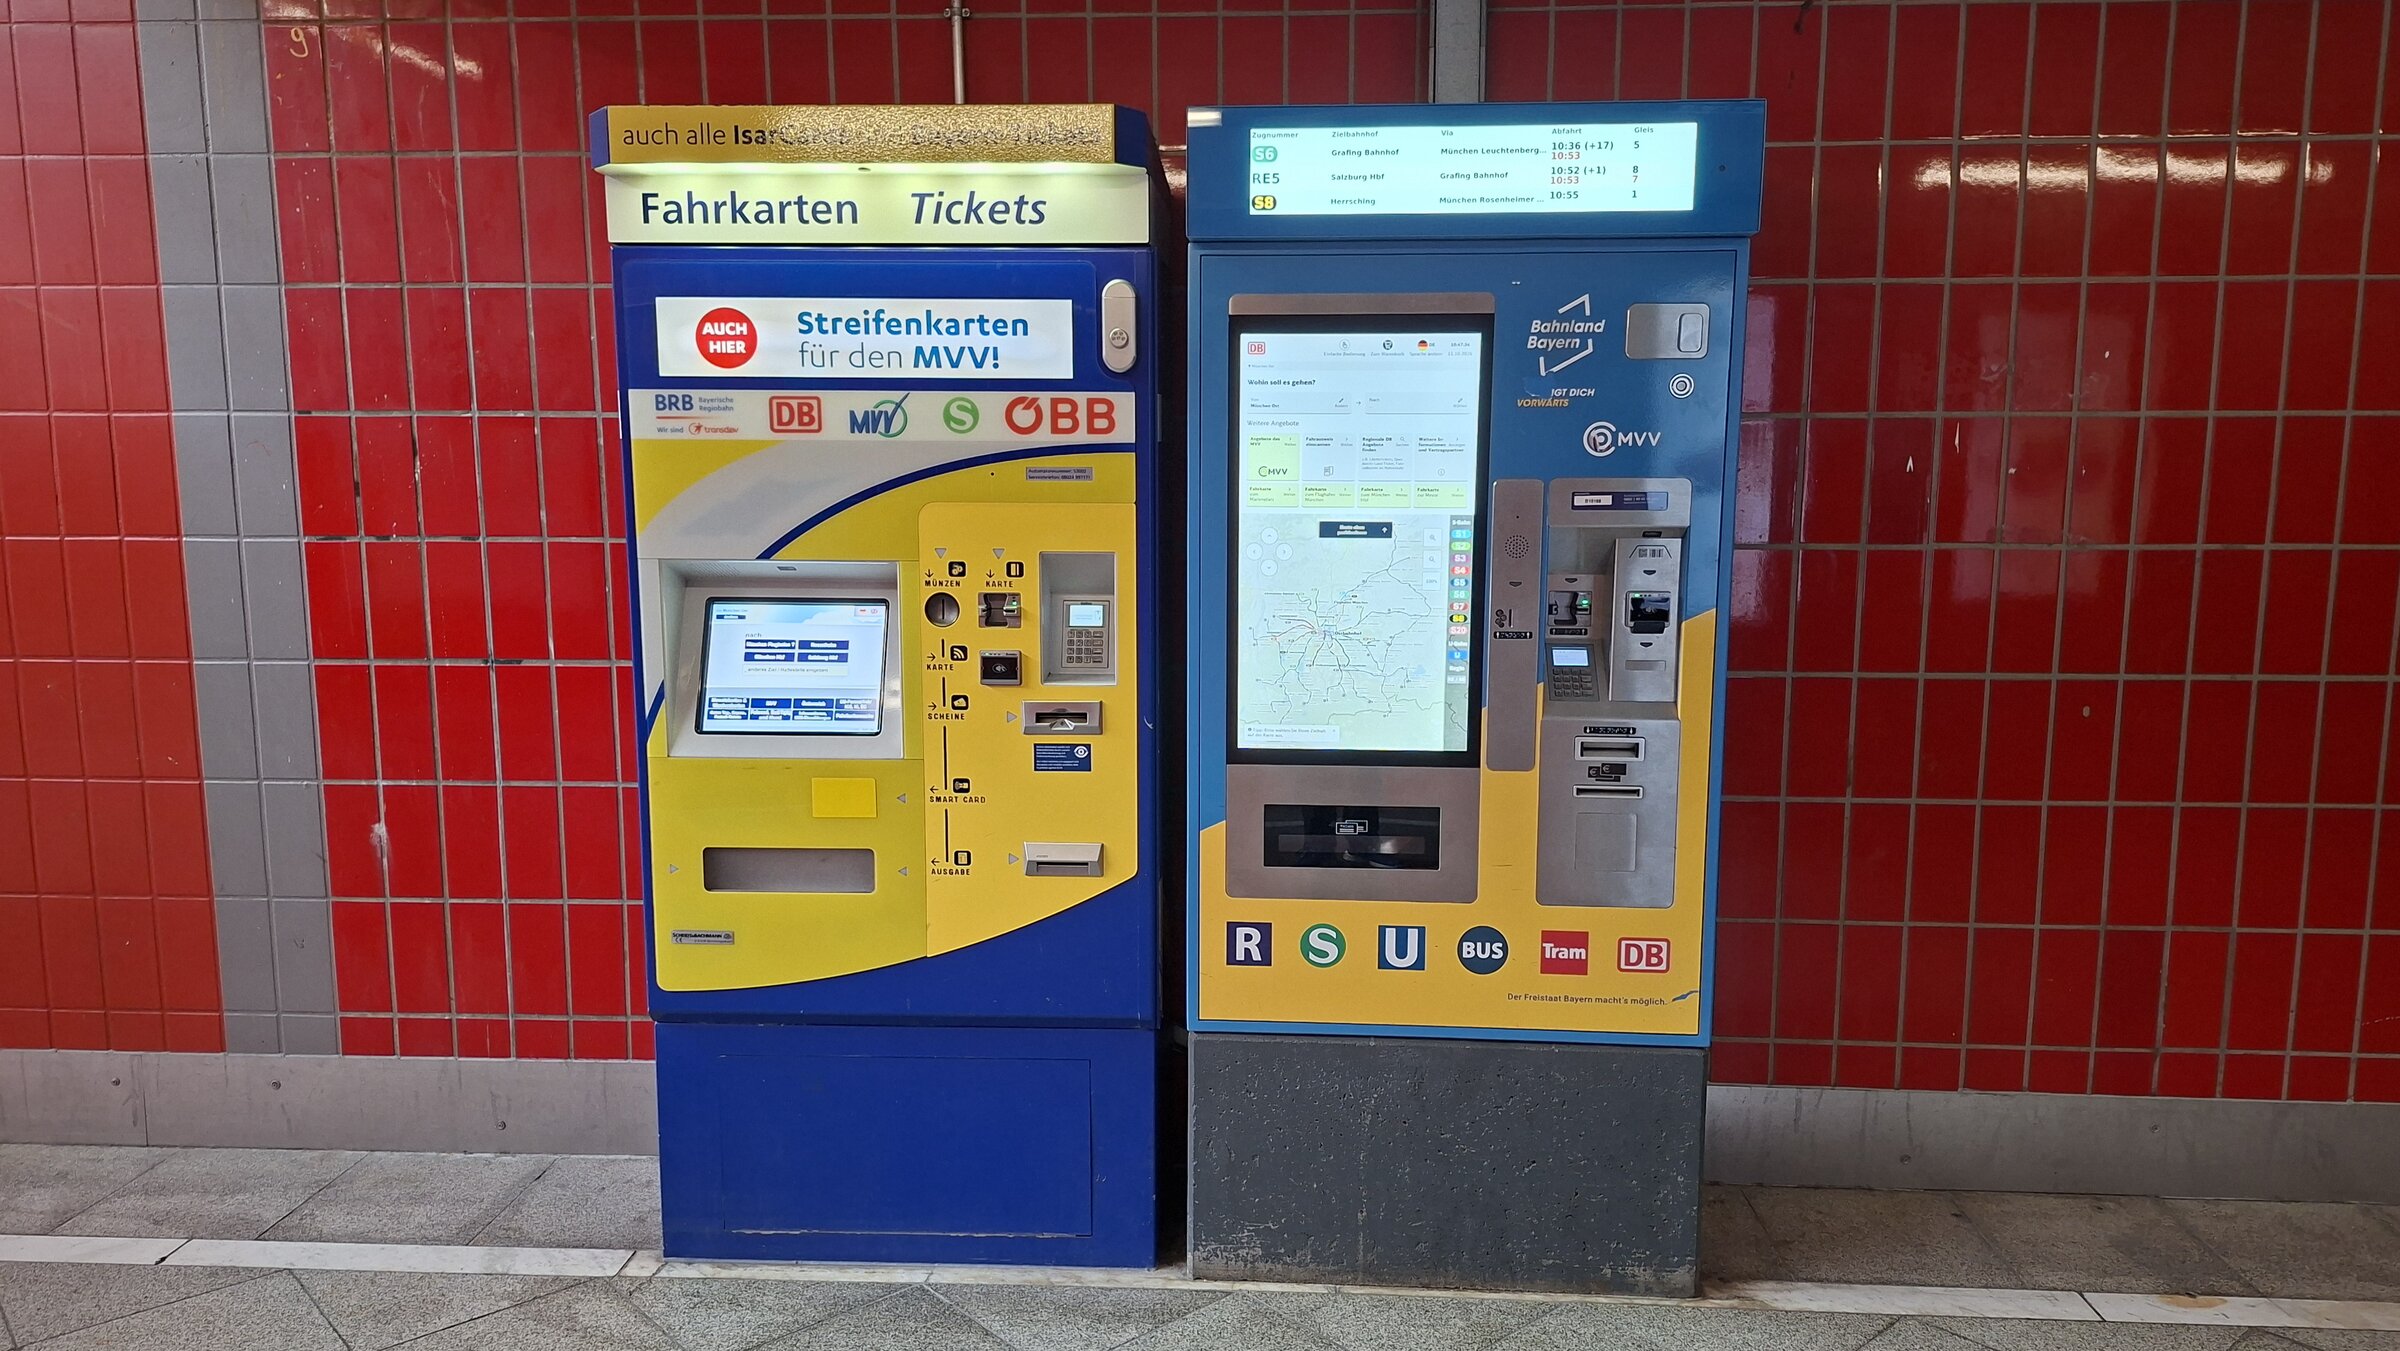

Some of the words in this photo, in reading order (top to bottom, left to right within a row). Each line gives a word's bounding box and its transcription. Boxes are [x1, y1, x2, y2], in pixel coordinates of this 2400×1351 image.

[622, 123, 679, 146] auch
[687, 122, 726, 146] alle
[1441, 129, 1454, 137] Via
[1552, 127, 1582, 135] Abfahrt
[1634, 126, 1654, 134] Gleis
[1252, 132, 1299, 140] Zugnummer
[1552, 141, 1581, 150] 10:36
[1584, 140, 1614, 151] (+17)
[1633, 141, 1640, 149] 5
[1253, 147, 1277, 161] S6
[1331, 149, 1362, 157] Grafing
[1364, 148, 1399, 156] Bahnhof
[1440, 147, 1479, 155] München
[1551, 152, 1581, 160] 10:53
[1551, 166, 1580, 175] 10:52
[1583, 166, 1606, 175] (+1)
[1632, 165, 1639, 174] 8
[1252, 173, 1280, 184] RE5
[1331, 174, 1367, 182] Salzburg
[1440, 172, 1471, 180] Grafing
[1473, 171, 1508, 179] Bahnhof
[1632, 175, 1638, 183] 7
[1550, 176, 1580, 185] 10:53
[1549, 191, 1579, 200] 10:55
[1631, 190, 1638, 198] 1
[1253, 196, 1276, 210] S8
[1330, 198, 1376, 206] Herrsching
[1479, 196, 1535, 204] Rosenheimer
[641, 191, 858, 225] Fahrkarten
[910, 191, 1047, 225] Tickets
[797, 310, 1029, 337] Streifenkarten
[1530, 319, 1606, 333] Bahnland
[702, 321, 748, 336] AUCH
[709, 340, 747, 355] HIER
[1249, 343, 1264, 353] DB
[1527, 336, 1580, 351] Bayern
[798, 343, 839, 369] für
[848, 342, 903, 369] den
[912, 346, 1000, 369] MVV!
[1291, 379, 1316, 387] gehen?
[1568, 388, 1596, 397] DICH
[655, 394, 694, 412] BRB
[698, 404, 734, 413] Regiobahn
[776, 401, 816, 427] DB
[849, 393, 910, 434] MVV
[946, 399, 977, 432] S
[1004, 396, 1116, 436] ÖBB
[656, 426, 669, 434] Wir
[670, 426, 684, 434] sind
[704, 425, 739, 434] transdev
[1617, 431, 1661, 447] MVV
[1454, 530, 1469, 538] S1
[1453, 542, 1468, 550] S2
[1453, 554, 1467, 562] S3
[1453, 566, 1467, 574] S4
[925, 579, 961, 587] MÜNZEN
[985, 580, 1014, 588] KARTE
[1453, 579, 1466, 587] S5
[1453, 591, 1466, 599] S6
[1452, 603, 1465, 611] S7
[1451, 614, 1465, 622] S8
[1450, 627, 1467, 635] S20
[962, 796, 986, 804] CARD
[931, 868, 970, 876] AUSGABE
[1234, 926, 1263, 962] R
[1307, 927, 1340, 965] S
[1384, 927, 1420, 968] U
[1462, 941, 1504, 960] BUS
[1542, 943, 1586, 960] Tram
[1624, 943, 1664, 967] DB
[1524, 993, 1561, 1002] Freistaat
[1563, 995, 1593, 1004] Bayern
[1594, 996, 1629, 1005] macht's
[1630, 997, 1668, 1007] möglich.
